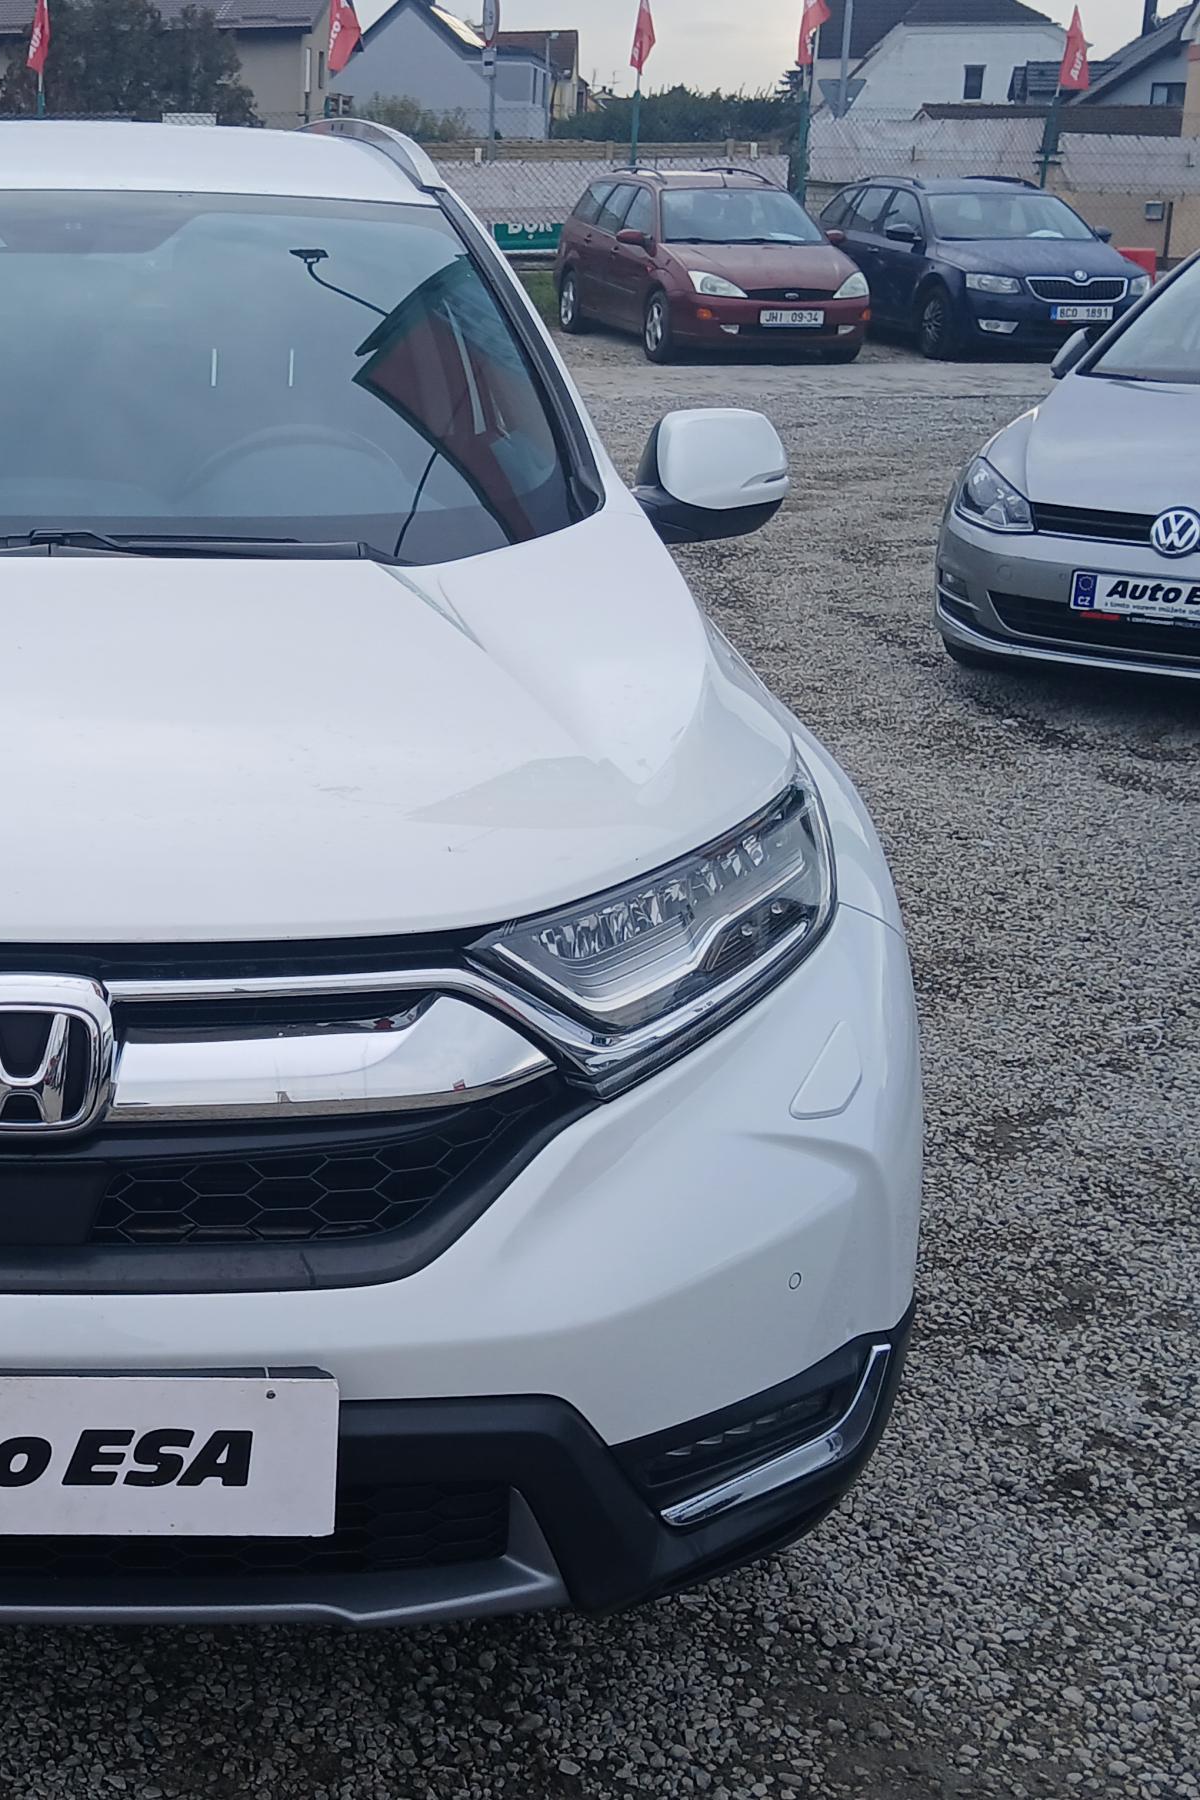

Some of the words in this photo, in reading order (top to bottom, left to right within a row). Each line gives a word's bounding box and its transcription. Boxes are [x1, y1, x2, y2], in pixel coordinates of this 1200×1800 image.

[765, 312, 783, 322] JHI
[1106, 580, 1183, 603] Auto
[1077, 596, 1091, 605] CZ
[61, 1428, 254, 1487] ESA
